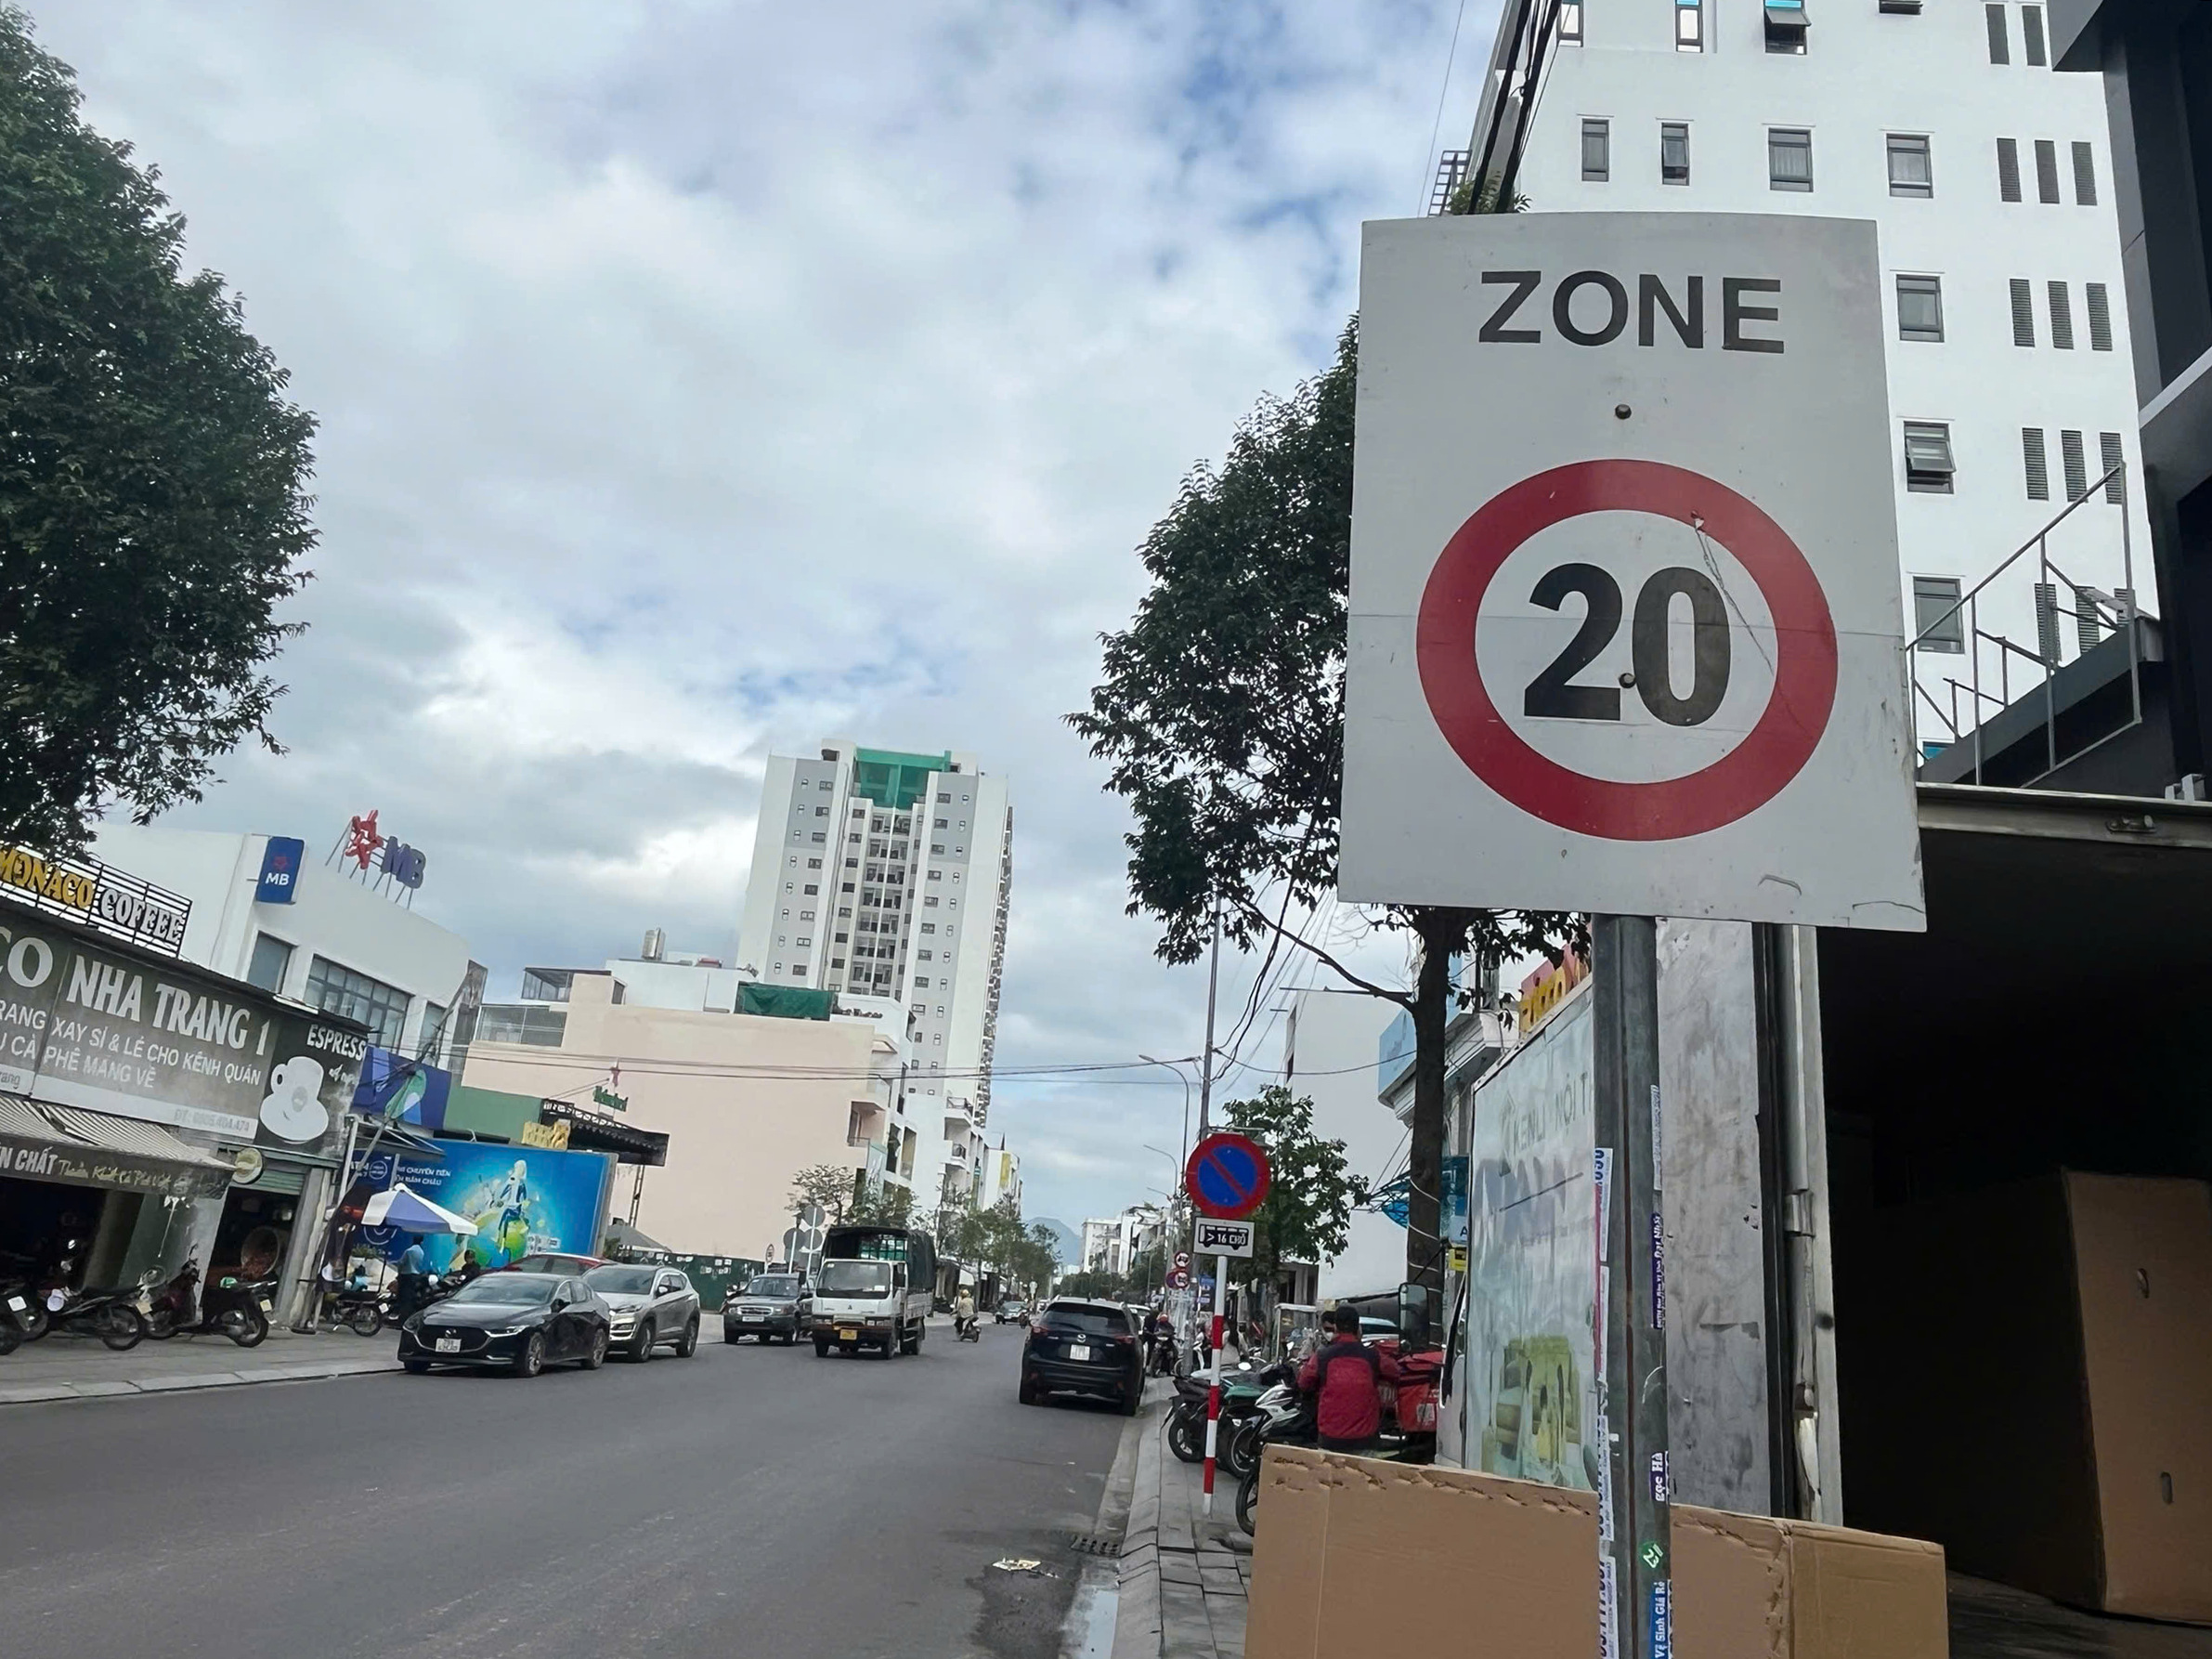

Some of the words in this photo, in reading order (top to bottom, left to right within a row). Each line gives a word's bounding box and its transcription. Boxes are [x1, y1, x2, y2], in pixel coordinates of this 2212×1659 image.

[1478, 269, 1785, 354] ZONE
[1523, 562, 1732, 728] 20
[266, 872, 290, 886] MB
[380, 836, 426, 889] MB
[0, 847, 94, 908] MONACO
[100, 888, 184, 943] COFFEE
[0, 926, 53, 988] O
[66, 954, 143, 1023] NHA
[152, 983, 251, 1050] TRANG
[255, 1019, 271, 1055] 1
[43, 1045, 81, 1071] PHÊ
[83, 1055, 131, 1082] MANG
[51, 1017, 87, 1042] XAY
[109, 1033, 120, 1052] &
[147, 1043, 179, 1066] CHO
[224, 1064, 262, 1086] QUÁN
[306, 1024, 366, 1061] ESPRESS
[14, 1146, 59, 1175] CHẤT
[1217, 1233, 1227, 1244] 16
[1655, 1617, 1666, 1641] Sinh
